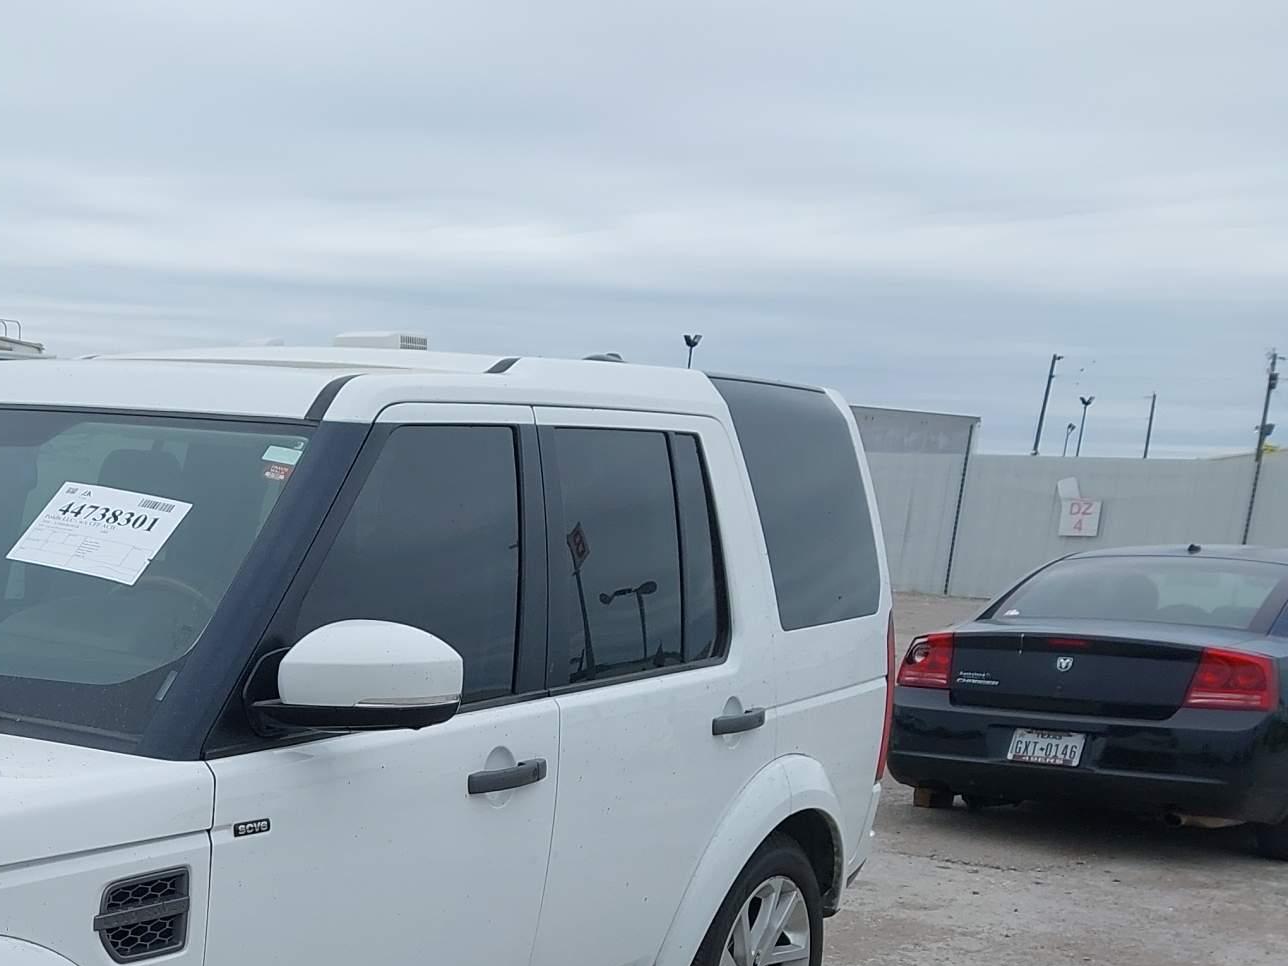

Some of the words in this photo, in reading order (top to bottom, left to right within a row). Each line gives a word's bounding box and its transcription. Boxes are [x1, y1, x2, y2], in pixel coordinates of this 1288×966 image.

[1070, 502, 1093, 516] DZ
[58, 500, 161, 533] 44738301
[1073, 519, 1083, 532] 4
[238, 820, 268, 835] SCV6
